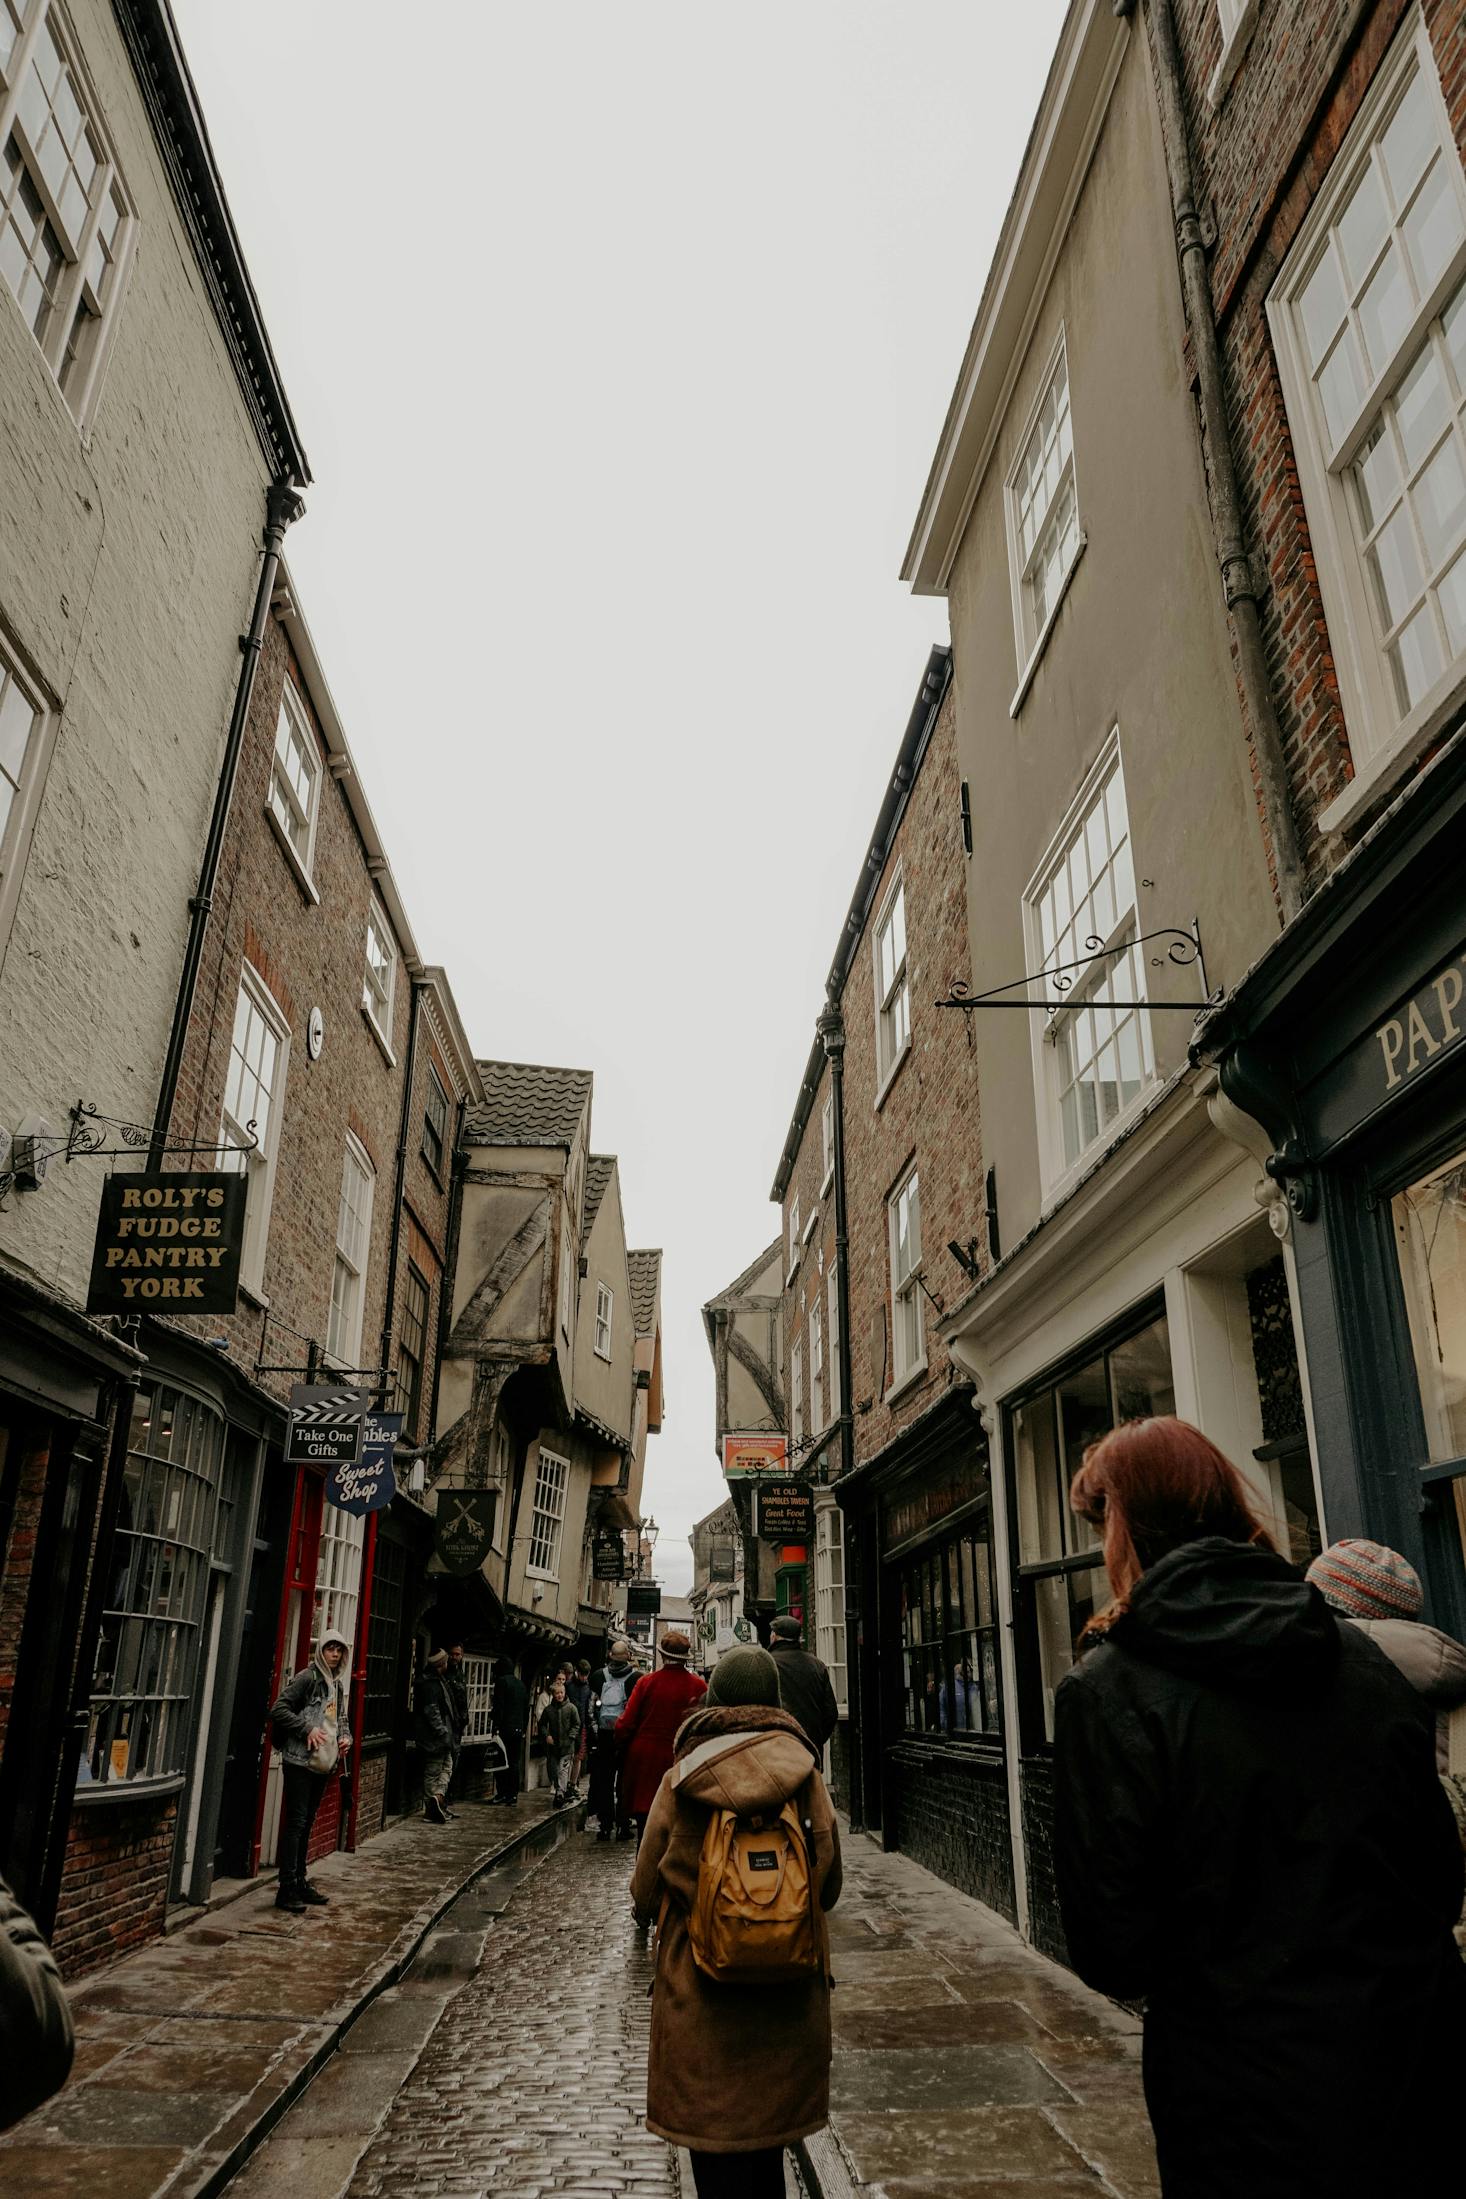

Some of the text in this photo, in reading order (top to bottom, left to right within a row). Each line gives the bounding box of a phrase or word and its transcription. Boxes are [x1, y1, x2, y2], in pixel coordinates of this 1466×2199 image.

[1376, 954, 1466, 1090] PAP
[121, 1188, 224, 1208] ROLY'S
[117, 1217, 221, 1237] FUDGE
[105, 1247, 228, 1268] PANTRY
[120, 1278, 204, 1298] YORK
[364, 1416, 378, 1427] he
[295, 1429, 354, 1442] Take One
[307, 1444, 338, 1456] Gifts
[334, 1457, 385, 1484] Sweet
[340, 1480, 378, 1503] Shop
[761, 1496, 810, 1505] SHAMBLES TAVERN
[765, 1508, 805, 1518] Great Food
